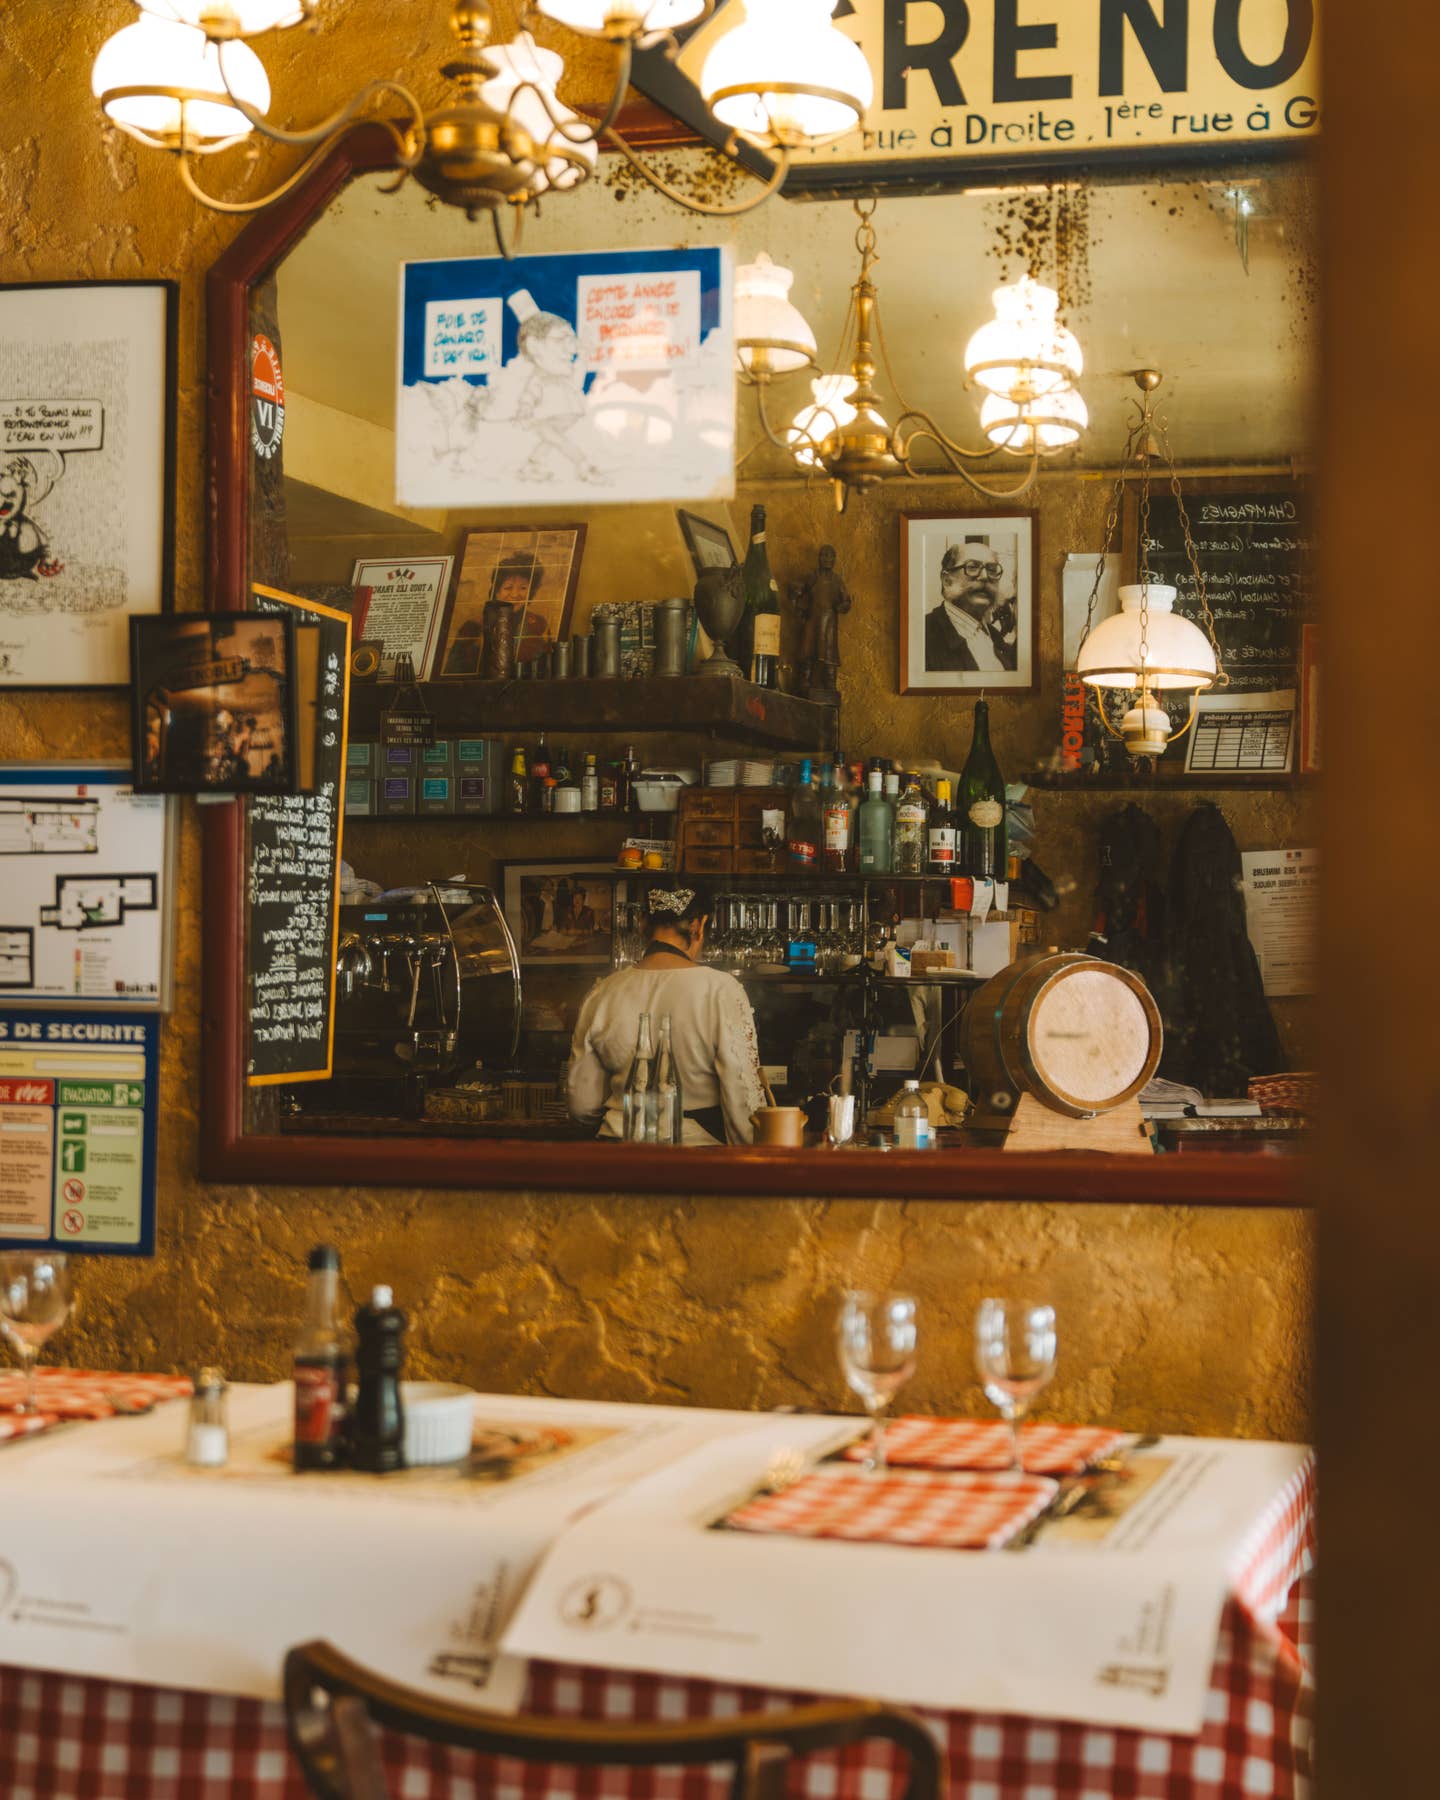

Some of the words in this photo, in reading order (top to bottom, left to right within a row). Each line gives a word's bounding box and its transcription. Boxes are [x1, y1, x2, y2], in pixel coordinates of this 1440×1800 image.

[831, 0, 1314, 110] RENO
[930, 119, 953, 148] à
[1171, 112, 1233, 135] rue
[1246, 103, 1270, 132] à
[39, 432, 54, 442] EN
[58, 431, 77, 440] VIN
[14, 1022, 42, 1039] DE
[48, 1023, 146, 1041] SECURITE
[63, 1087, 112, 1103] EVACUATION
